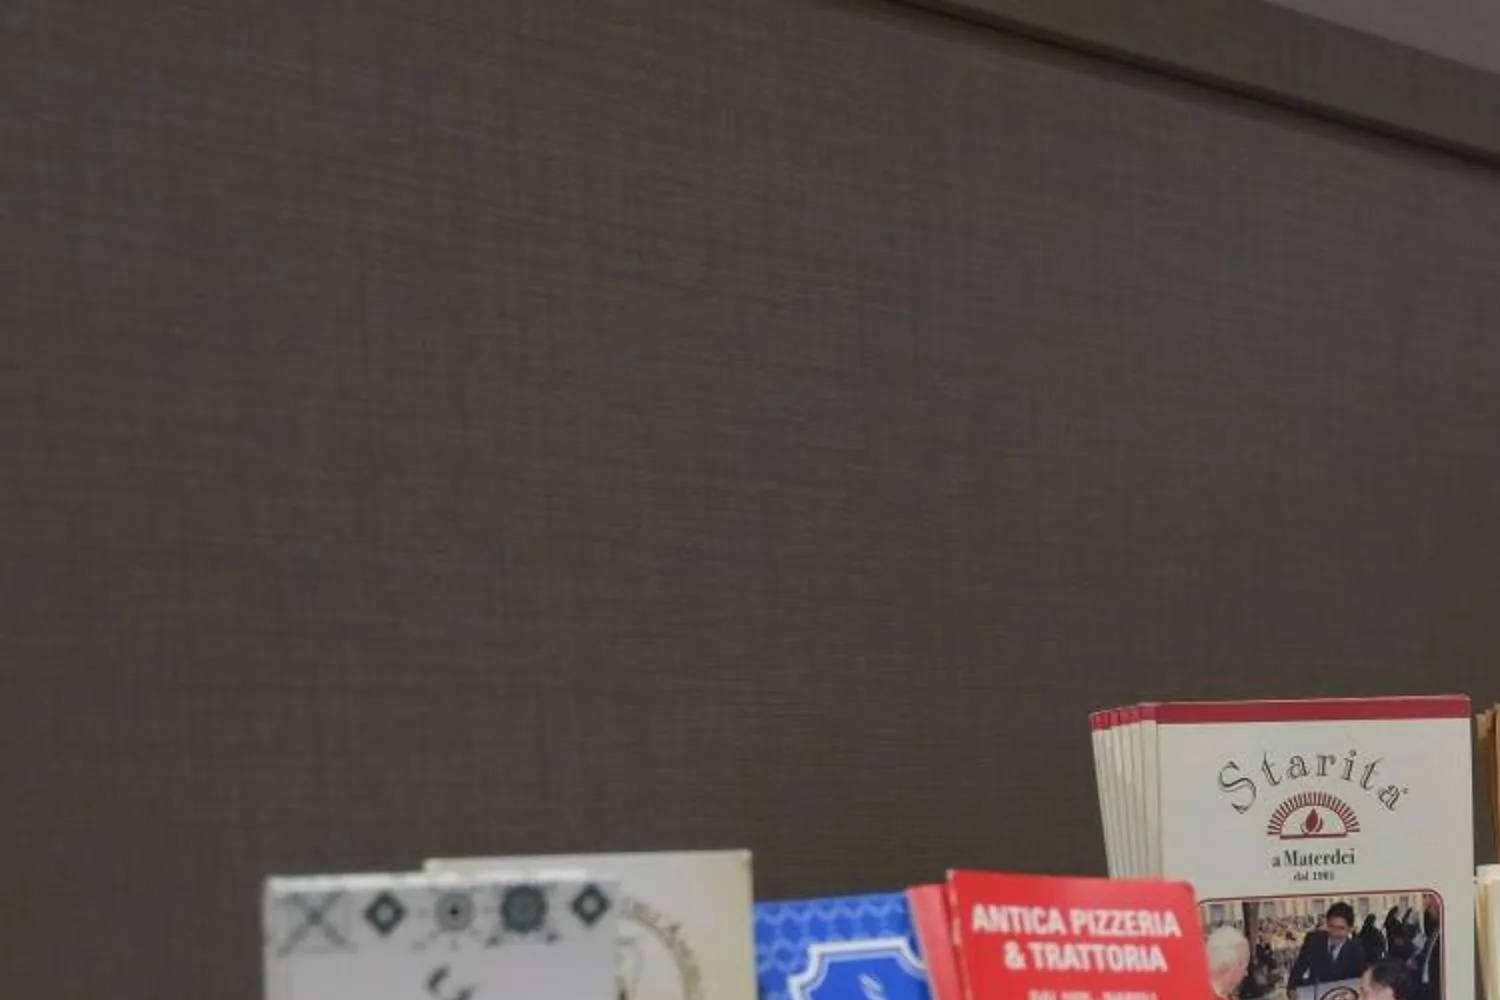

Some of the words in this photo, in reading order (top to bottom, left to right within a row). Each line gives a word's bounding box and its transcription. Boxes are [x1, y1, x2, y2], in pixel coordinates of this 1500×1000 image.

[1271, 856, 1281, 868] a
[1284, 847, 1356, 867] Materdei
[972, 902, 1067, 937] ANTICA
[1069, 907, 1183, 938] PIZZERIA
[1003, 940, 1028, 970] &
[1027, 941, 1168, 973] TRATTORIA
